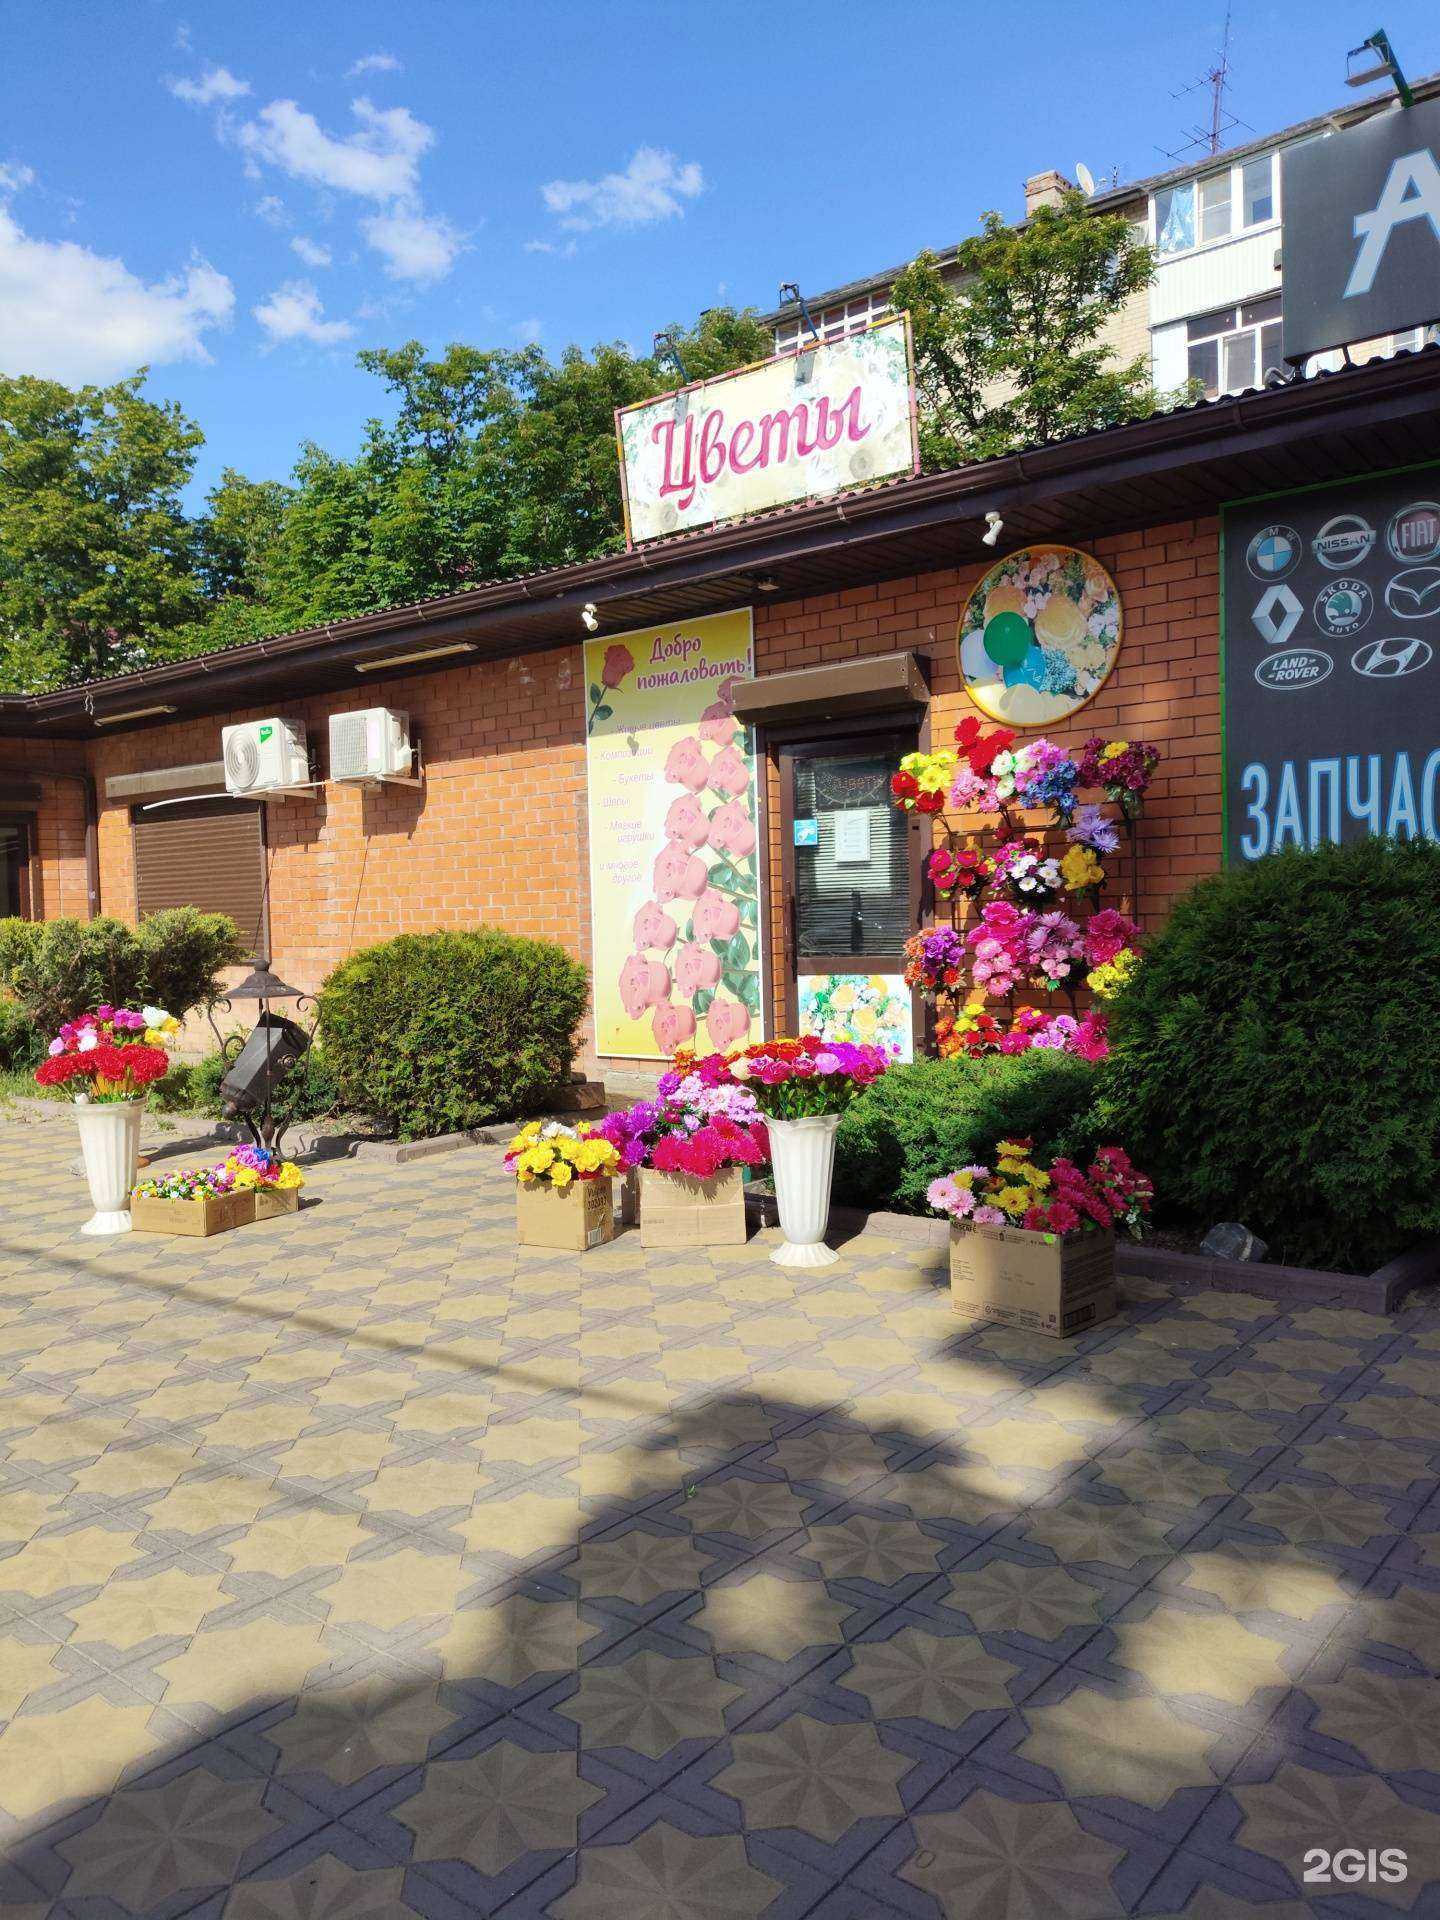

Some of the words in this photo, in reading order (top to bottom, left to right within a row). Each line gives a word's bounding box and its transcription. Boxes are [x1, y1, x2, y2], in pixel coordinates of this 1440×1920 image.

[651, 386, 872, 510] Цветы
[1401, 518, 1437, 549] FIAT
[1316, 534, 1371, 551] NISSAN
[1328, 622, 1360, 634] AUTO
[649, 632, 702, 665] Добро
[636, 647, 752, 690] пожаловать!
[1272, 656, 1309, 671] LAND
[1275, 666, 1320, 681] ROVER
[618, 772, 654, 786] Букеты
